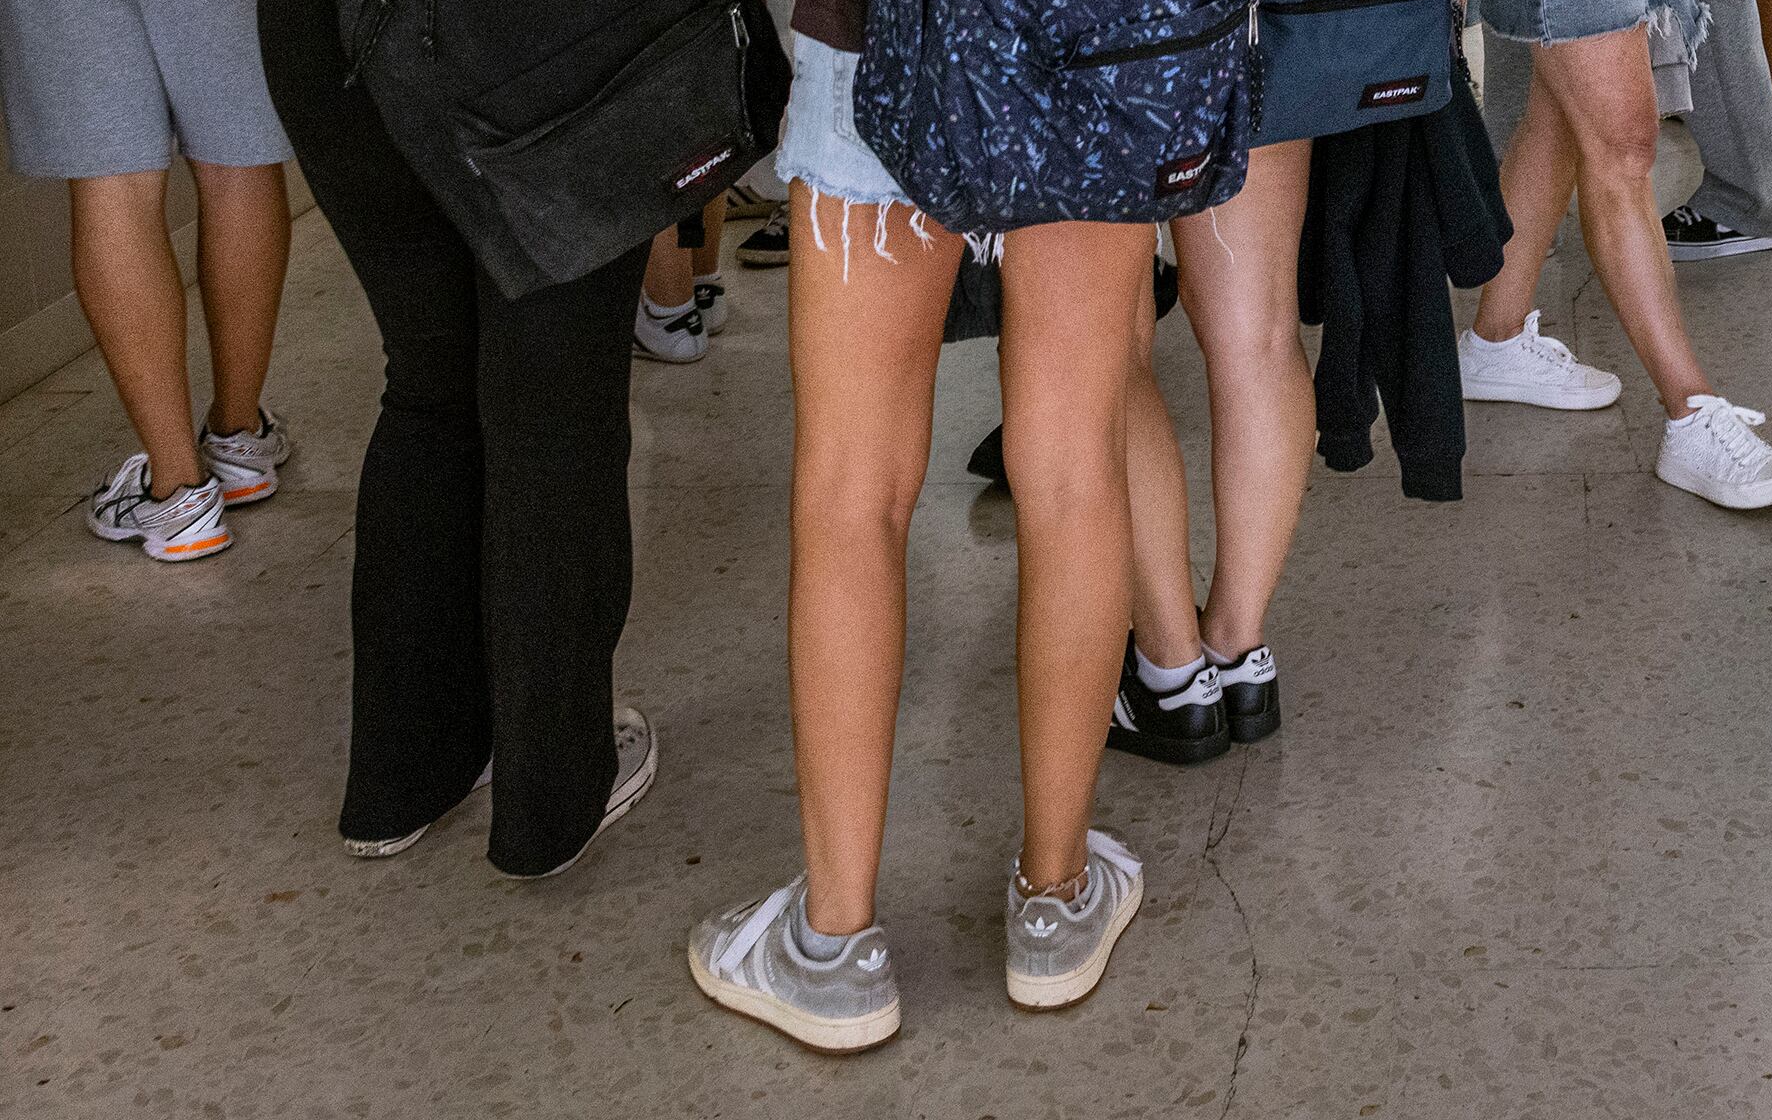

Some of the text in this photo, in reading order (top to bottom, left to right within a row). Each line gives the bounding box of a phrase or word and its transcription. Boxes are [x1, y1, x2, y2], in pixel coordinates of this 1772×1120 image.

[1372, 85, 1418, 100] EASTPAK
[676, 147, 732, 189] EASTPAK
[1253, 665, 1274, 678] adidas
[1201, 687, 1221, 699] adidas
